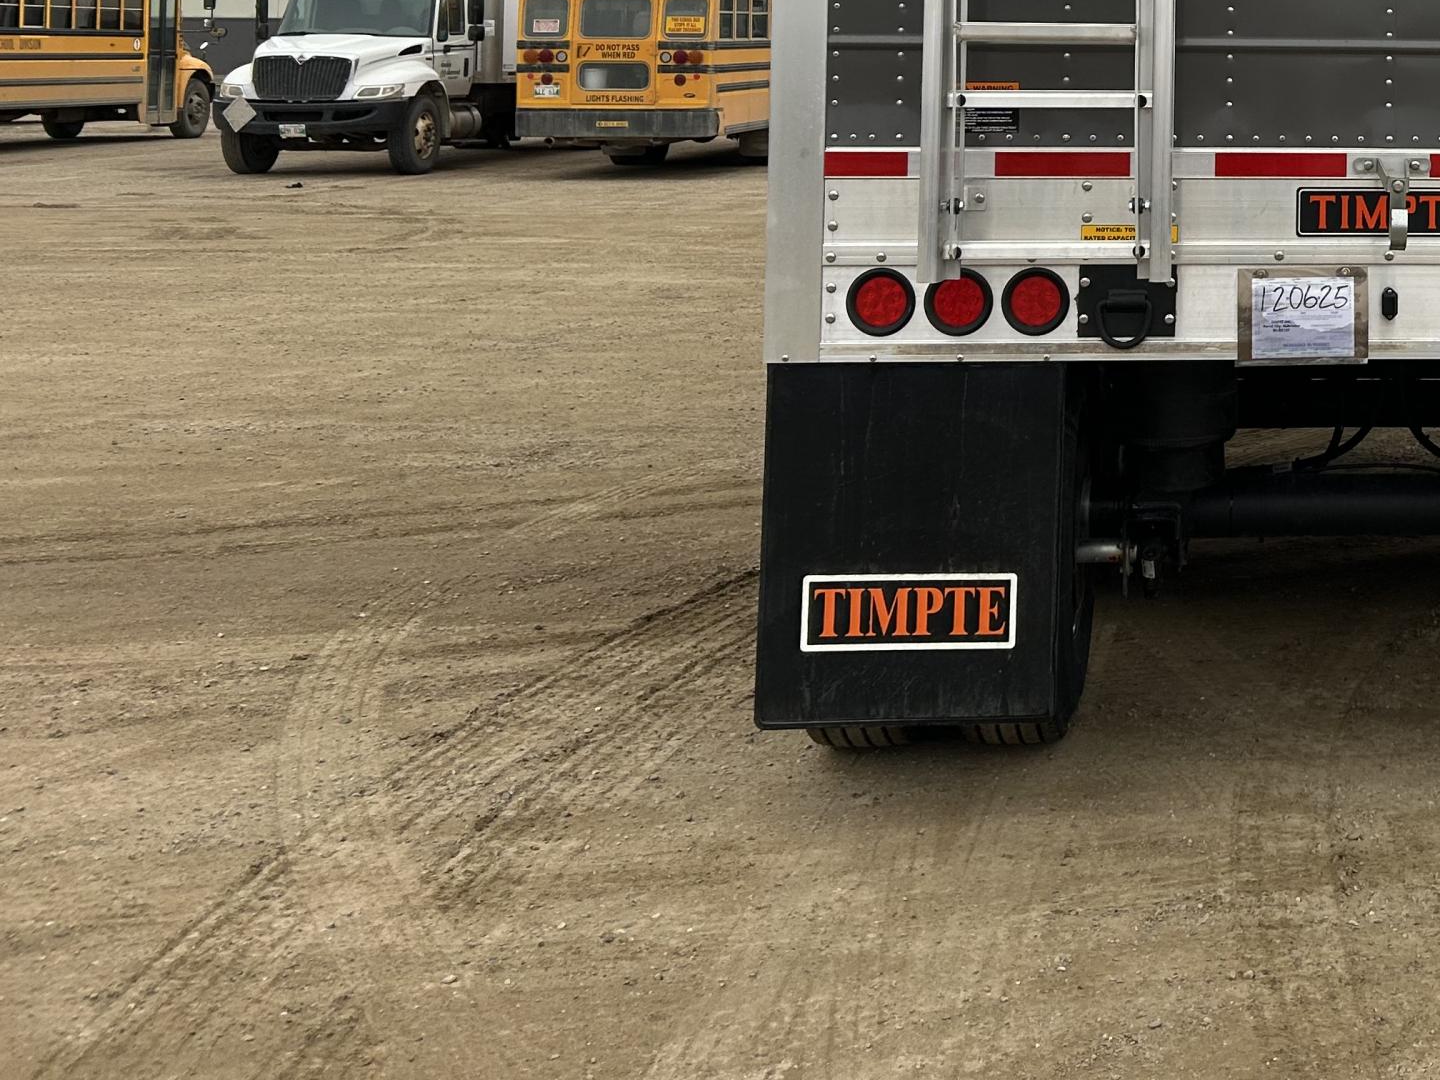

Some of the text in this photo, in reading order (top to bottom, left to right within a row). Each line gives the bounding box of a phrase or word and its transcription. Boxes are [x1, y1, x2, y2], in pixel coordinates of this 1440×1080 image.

[622, 44, 640, 52] PASS
[601, 51, 621, 59] WHEN
[585, 95, 644, 103] LIGHTS FLASHING
[1260, 285, 1349, 312] 120625
[813, 586, 1006, 638] TIMPTE
